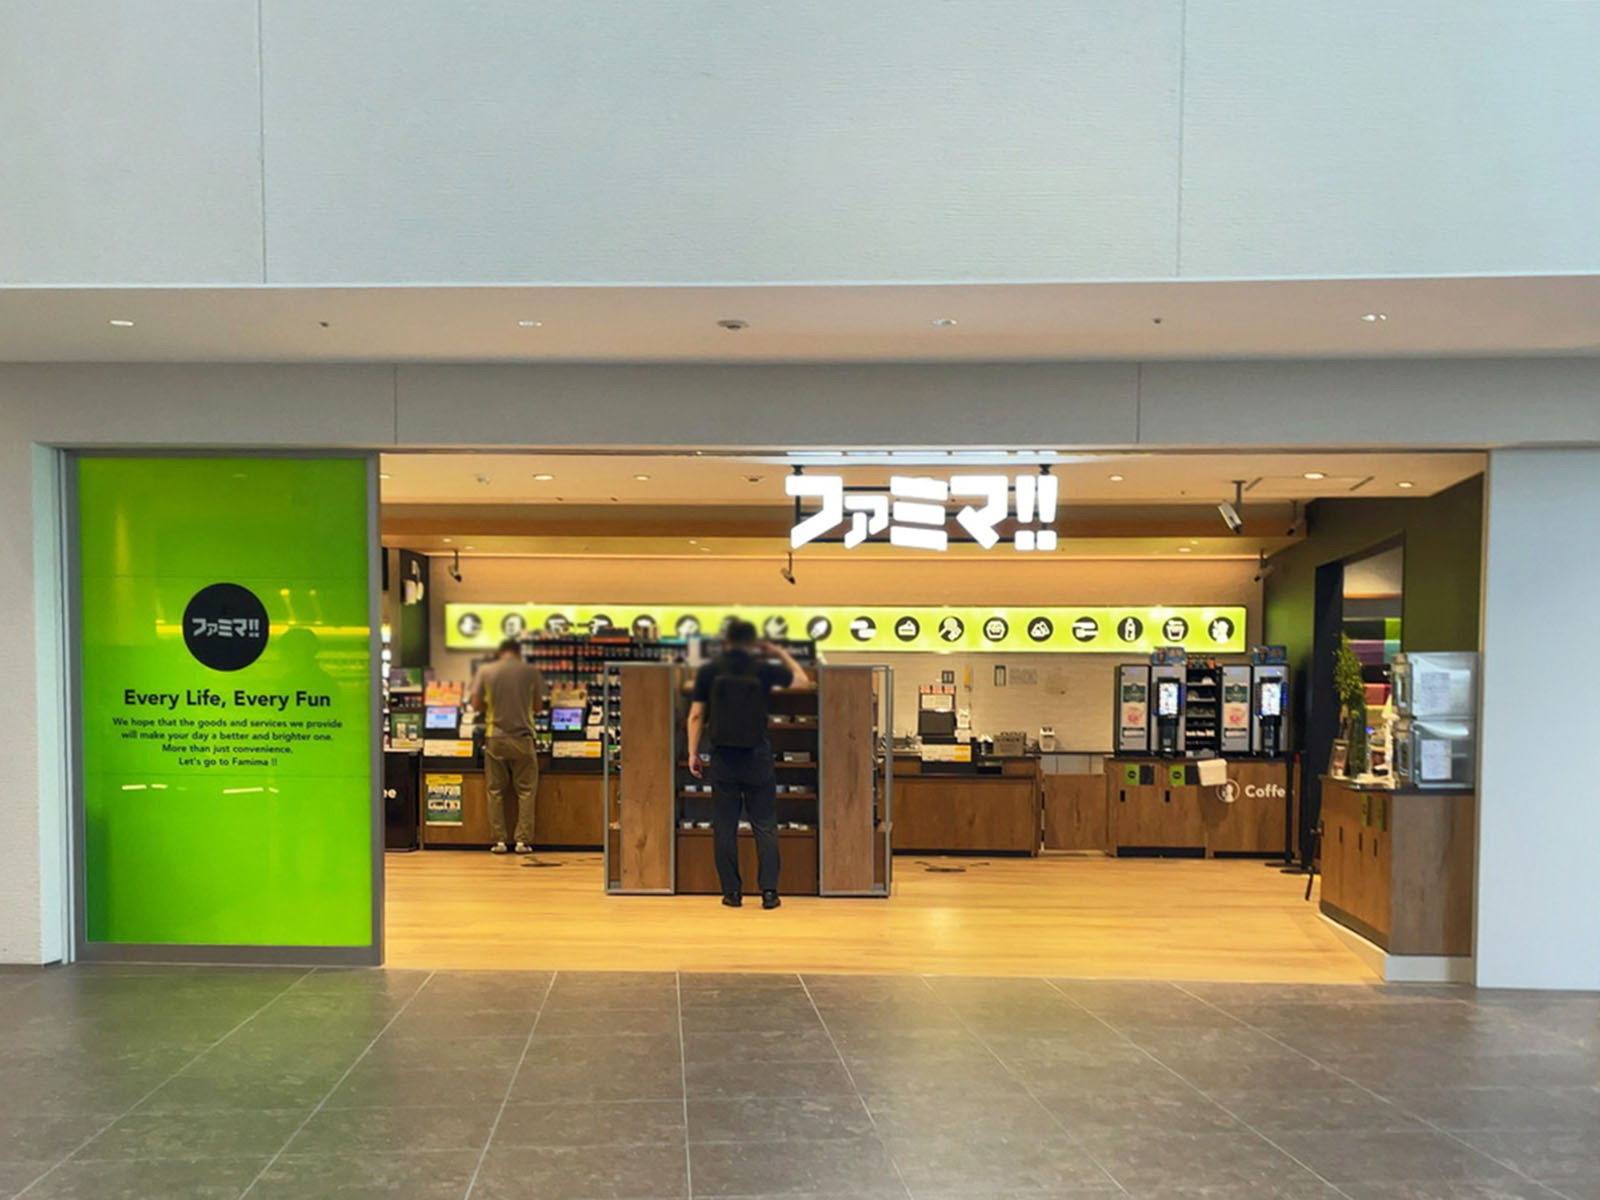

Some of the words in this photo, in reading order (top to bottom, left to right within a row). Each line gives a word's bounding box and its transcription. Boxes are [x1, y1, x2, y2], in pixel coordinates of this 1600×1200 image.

[785, 475, 1058, 551] ファミマ!!
[124, 689, 179, 710] Every
[186, 689, 226, 708] Life,
[234, 690, 290, 712] Every
[295, 691, 331, 707] Fun
[112, 717, 128, 726] We
[131, 718, 155, 728] hope
[157, 717, 177, 726] that
[179, 718, 195, 726] the
[198, 718, 227, 729] goods
[230, 719, 247, 727] and
[250, 719, 288, 728] services
[306, 719, 343, 730] provide
[121, 731, 138, 739] will
[140, 731, 165, 739] make
[168, 733, 189, 742] your
[192, 731, 209, 742] day
[220, 731, 249, 740] better
[252, 731, 270, 740] and
[272, 731, 311, 742] brighter
[162, 744, 187, 753] More
[189, 745, 210, 753] than
[212, 745, 230, 754] just
[233, 745, 293, 754] convenience.
[178, 757, 201, 766] Let's
[203, 759, 216, 768] go
[219, 758, 229, 766] to
[232, 757, 269, 766] Famima
